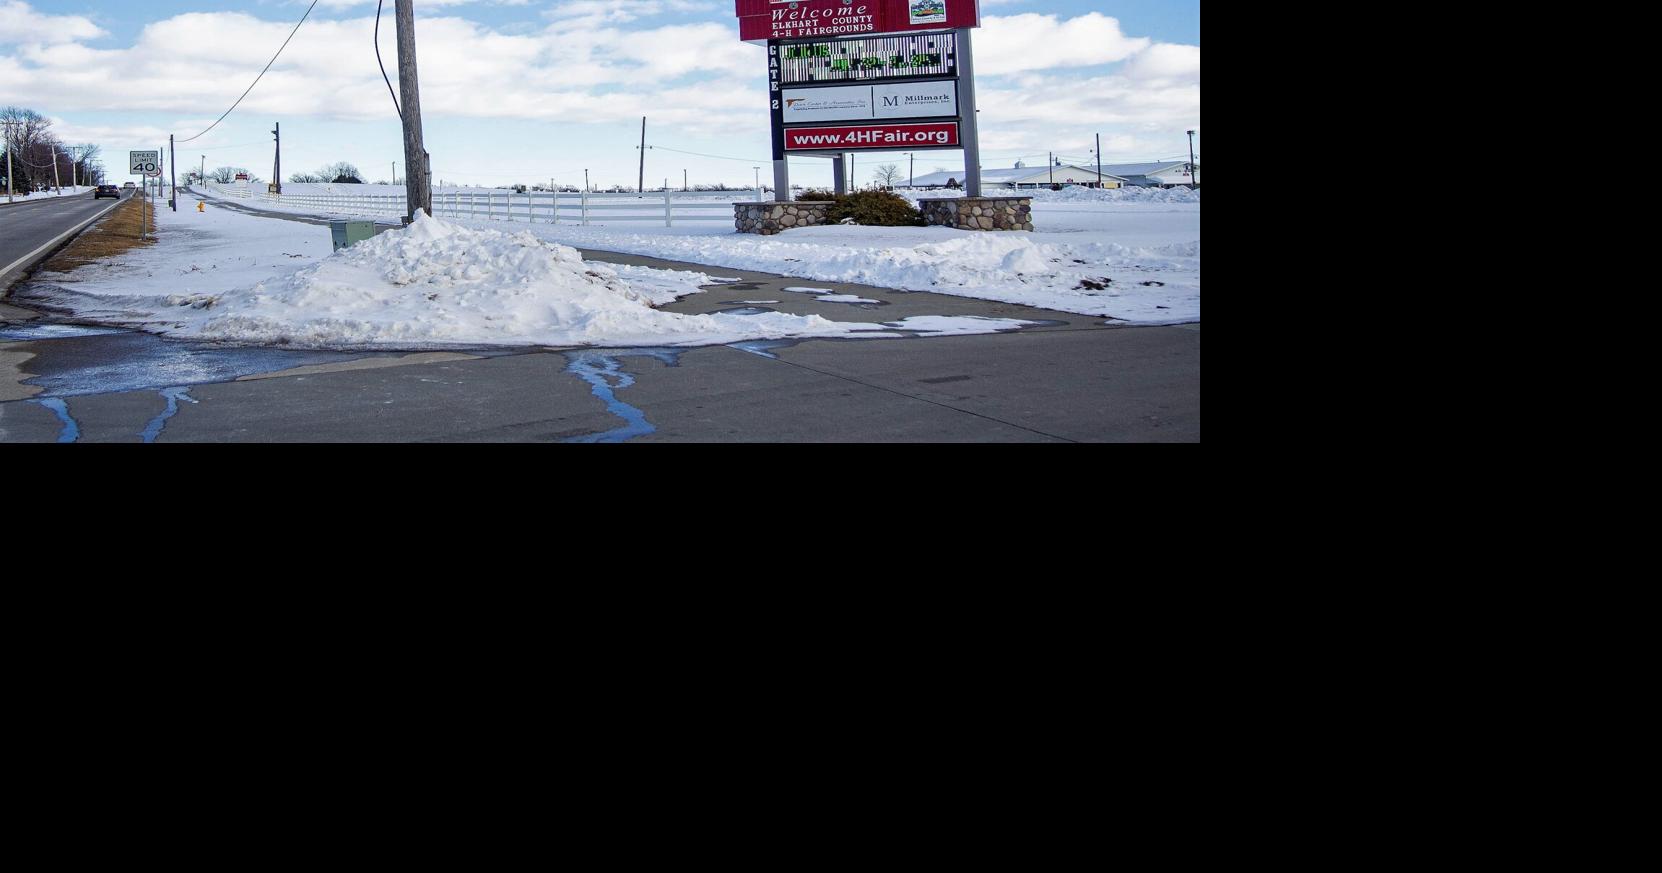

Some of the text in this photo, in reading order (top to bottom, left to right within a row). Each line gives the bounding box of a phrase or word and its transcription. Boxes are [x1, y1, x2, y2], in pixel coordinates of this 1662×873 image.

[771, 5, 867, 22] Welcome
[772, 15, 874, 30] ELKHART COUNTY
[772, 23, 874, 37] 4-H FAIRGROUNDS
[769, 45, 780, 110] GATE 2
[883, 95, 898, 107] M
[904, 93, 950, 102] Millmark
[793, 129, 949, 145] www.4HFair.org
[133, 162, 155, 172] 40
